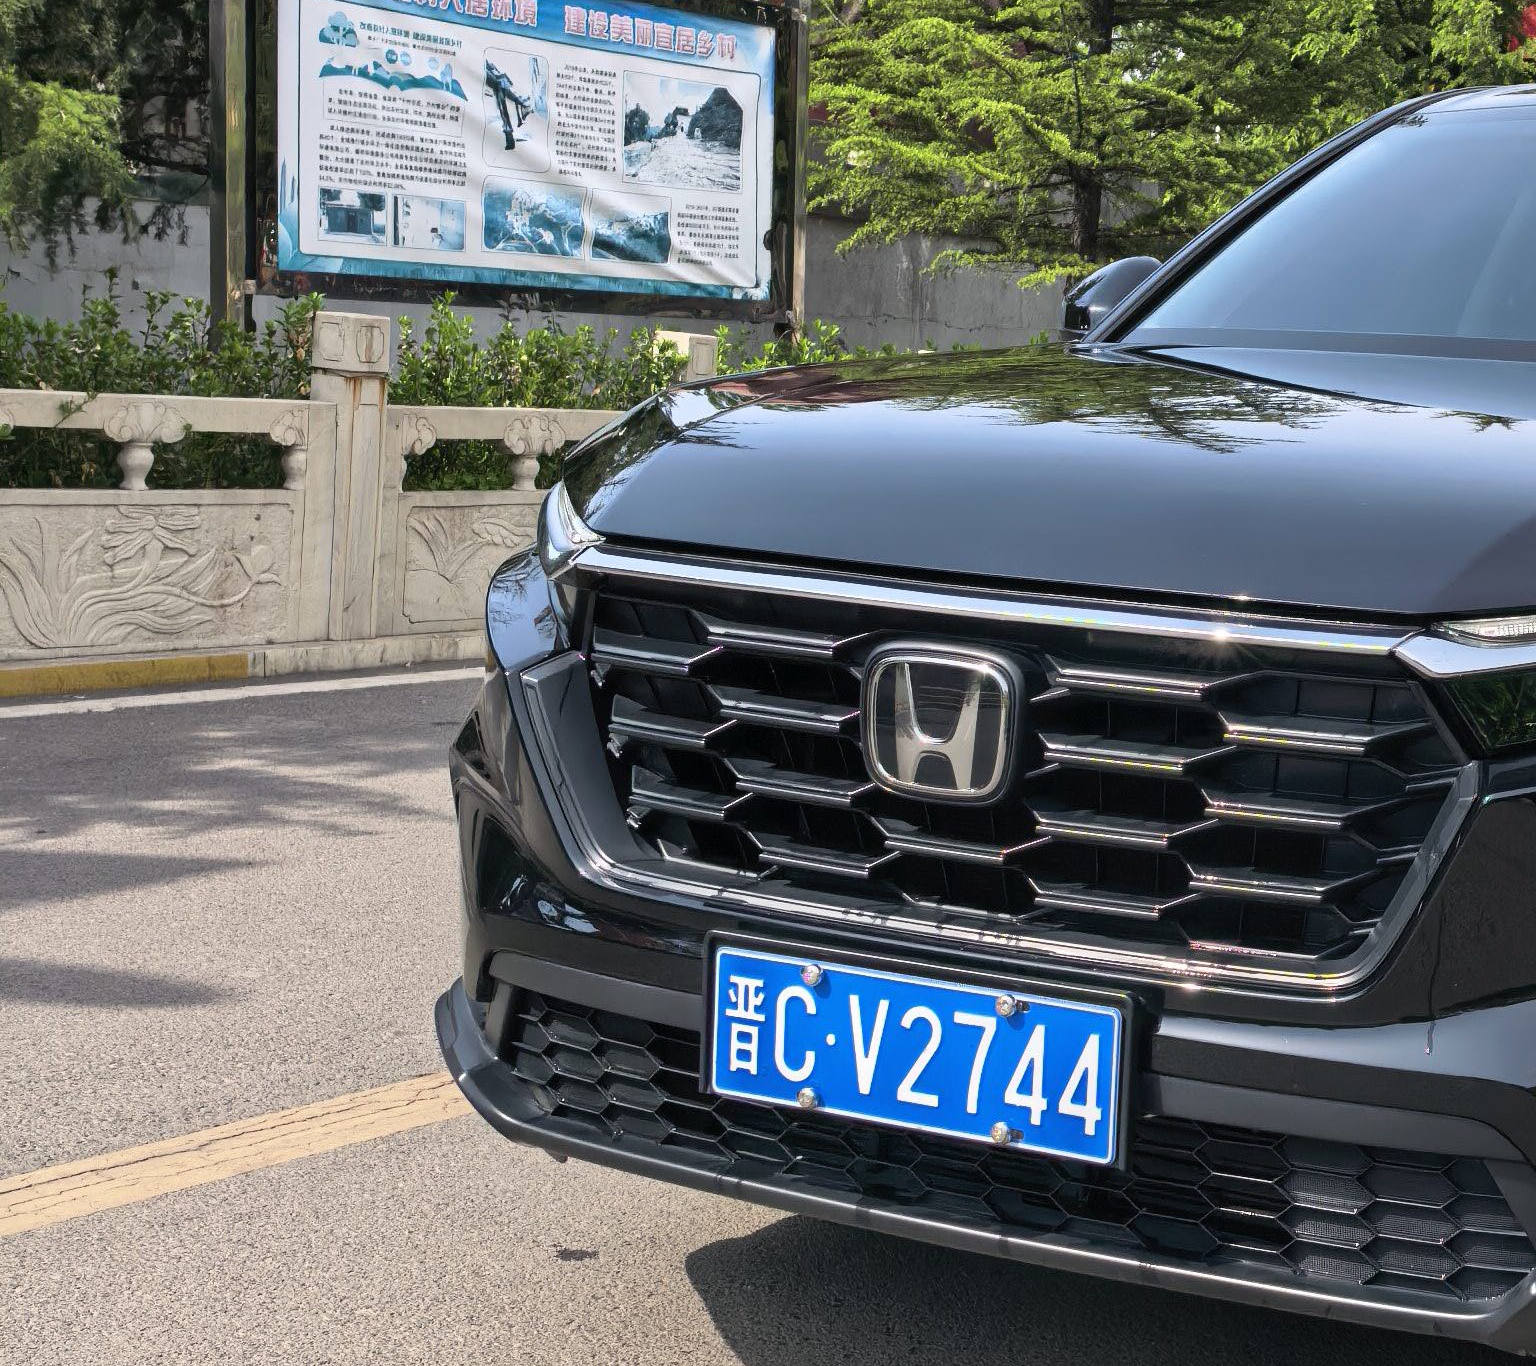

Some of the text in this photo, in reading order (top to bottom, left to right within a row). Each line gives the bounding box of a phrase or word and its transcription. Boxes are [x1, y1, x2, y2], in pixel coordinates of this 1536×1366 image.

[564, 5, 737, 60] 建设美丽宜居乡村
